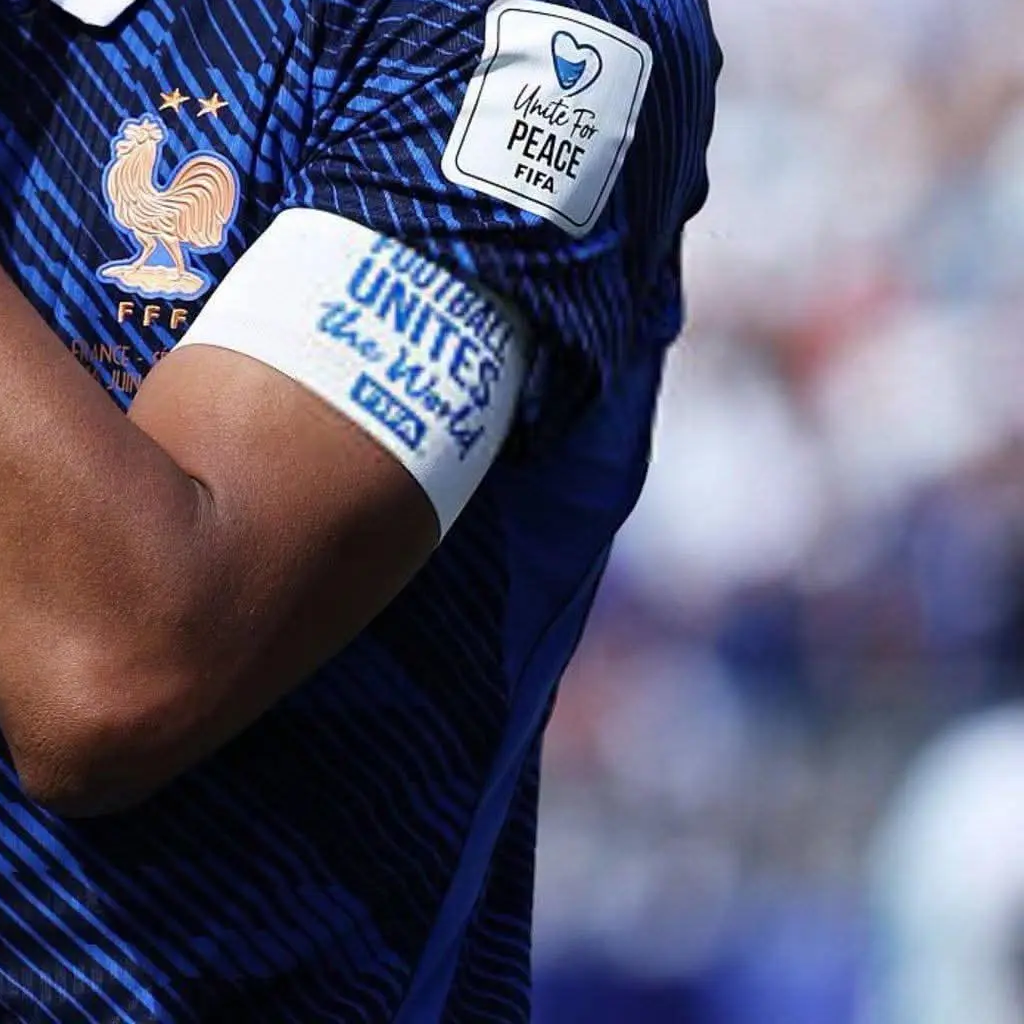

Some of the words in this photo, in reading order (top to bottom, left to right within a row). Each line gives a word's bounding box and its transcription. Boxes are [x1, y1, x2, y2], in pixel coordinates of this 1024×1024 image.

[512, 83, 569, 127] Unite
[570, 108, 599, 140] For
[507, 119, 585, 180] PEACE
[514, 163, 556, 194] FIFA
[117, 301, 189, 330] FFF
[348, 255, 501, 408] UNITES
